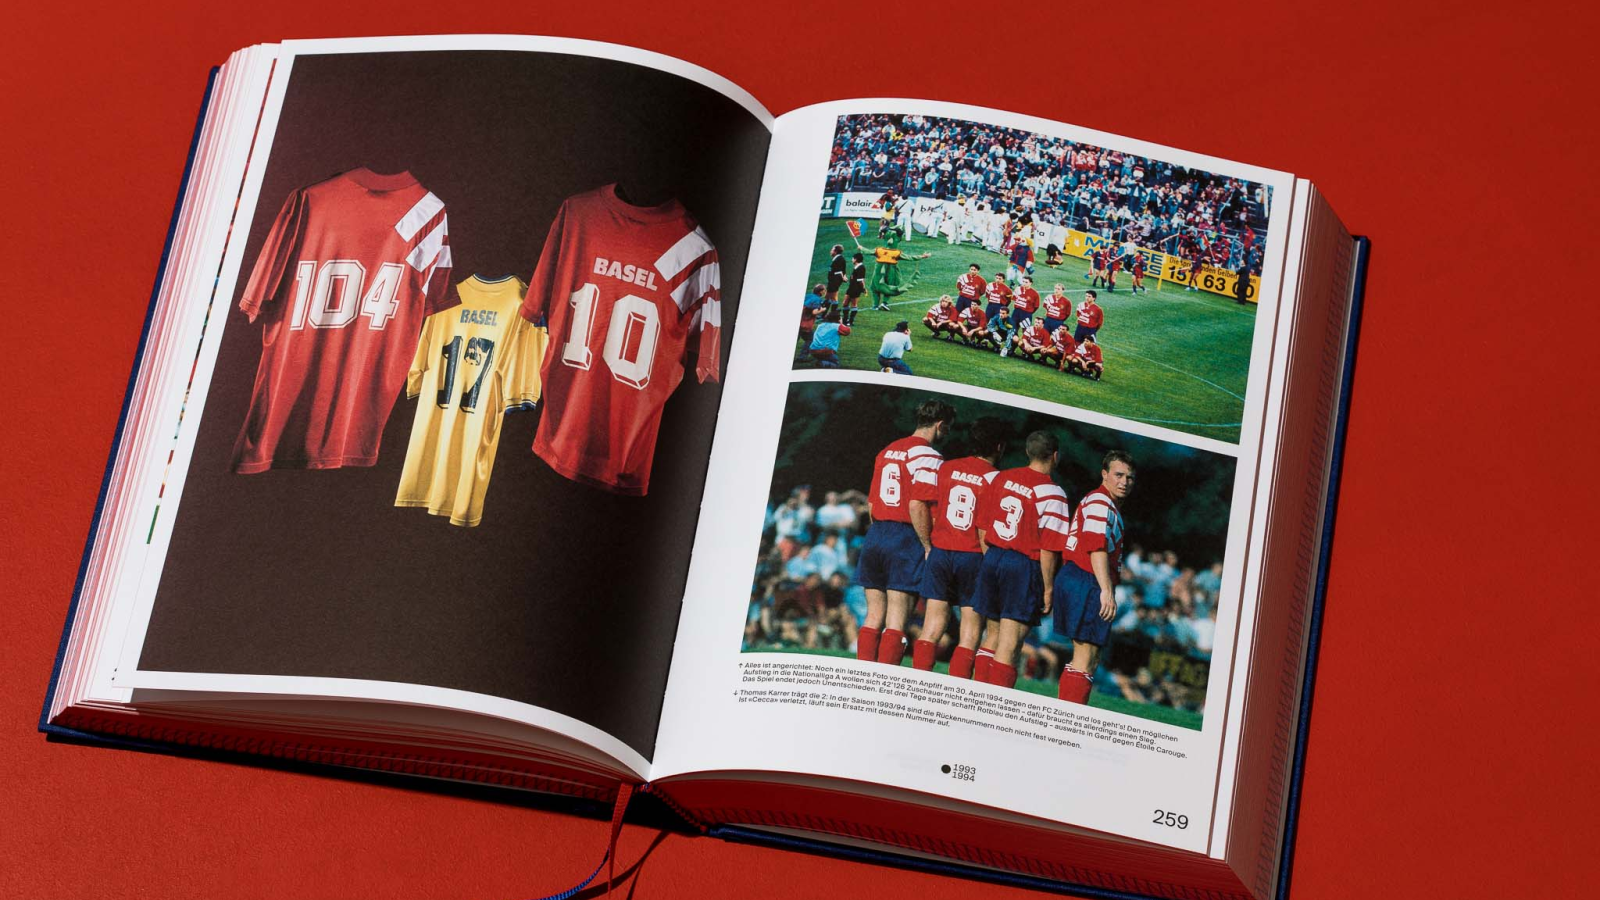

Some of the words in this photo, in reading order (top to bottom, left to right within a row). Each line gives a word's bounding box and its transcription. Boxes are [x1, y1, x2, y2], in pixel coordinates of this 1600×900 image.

[845, 199, 872, 207] balair
[593, 257, 658, 291] BASEL
[1204, 275, 1226, 291] 63
[290, 259, 405, 331] 104
[460, 309, 498, 326] BASEL
[562, 282, 661, 391] 10
[436, 335, 495, 415] 17
[879, 462, 901, 507] 6
[950, 470, 983, 487] BASEL
[1003, 480, 1033, 499] BASEL
[946, 484, 977, 532] 8
[993, 495, 1024, 542] 3
[740, 689, 767, 697] Thomas
[768, 689, 790, 697] Karrer
[791, 691, 808, 699] trägt
[851, 696, 876, 706] Saison
[877, 700, 906, 711] 1993/94
[907, 706, 923, 714] sind
[923, 709, 935, 717] die
[936, 711, 995, 730] Rückennummern
[995, 725, 1014, 734] noch
[1014, 728, 1032, 738] nicht
[1033, 732, 1047, 741] fest
[1047, 736, 1082, 749] vergeben.
[772, 663, 814, 671] angerichtet:
[815, 665, 834, 673] Noch
[847, 668, 871, 678] letztes
[872, 672, 888, 680] Foto
[902, 677, 918, 685] dem
[919, 680, 942, 690] Anpfiff
[955, 687, 967, 695] 30.
[968, 690, 985, 699] April
[986, 694, 1003, 702] 1994
[1004, 698, 1027, 708] gegen
[1027, 703, 1041, 711] den
[1042, 706, 1052, 714] FC
[1053, 708, 1075, 719] Zürich
[1090, 717, 1101, 725] los
[1127, 725, 1141, 734] Den
[1142, 729, 1179, 742] möglichen
[779, 698, 807, 706] verletzt,
[842, 702, 864, 711] Ersatz
[878, 709, 905, 718] dessen
[905, 713, 937, 724] Nummer
[937, 719, 950, 727] auf.
[792, 670, 835, 680] Nationalliga
[841, 675, 865, 683] wollen
[865, 678, 880, 686] sich
[906, 684, 944, 697] Zuschauer
[945, 691, 963, 701] nicht
[963, 697, 997, 709] entgehen
[997, 703, 1021, 713] lassen
[1026, 709, 1045, 719] dafür
[1046, 714, 1073, 726] braucht
[1083, 723, 1117, 736] allerdings
[1118, 731, 1138, 740] einen
[1138, 735, 1157, 745] Sieg.
[796, 677, 821, 685] jedoch
[822, 679, 877, 693] Unentschieden.
[878, 686, 893, 695] Erst
[893, 689, 909, 698] drei
[909, 692, 927, 701] Tage
[927, 695, 950, 706] später
[951, 701, 976, 710] schafft
[976, 704, 1004, 716] Rotblau
[1004, 711, 1019, 719] den
[1019, 715, 1048, 728] Aufstieg
[1054, 724, 1085, 736] auswärts
[1094, 732, 1111, 741] Genf
[1112, 737, 1135, 746] gegen
[1155, 746, 1187, 759] Carouge.
[952, 771, 975, 782] 1994
[953, 764, 976, 775] 1993
[1152, 809, 1189, 830] 259
